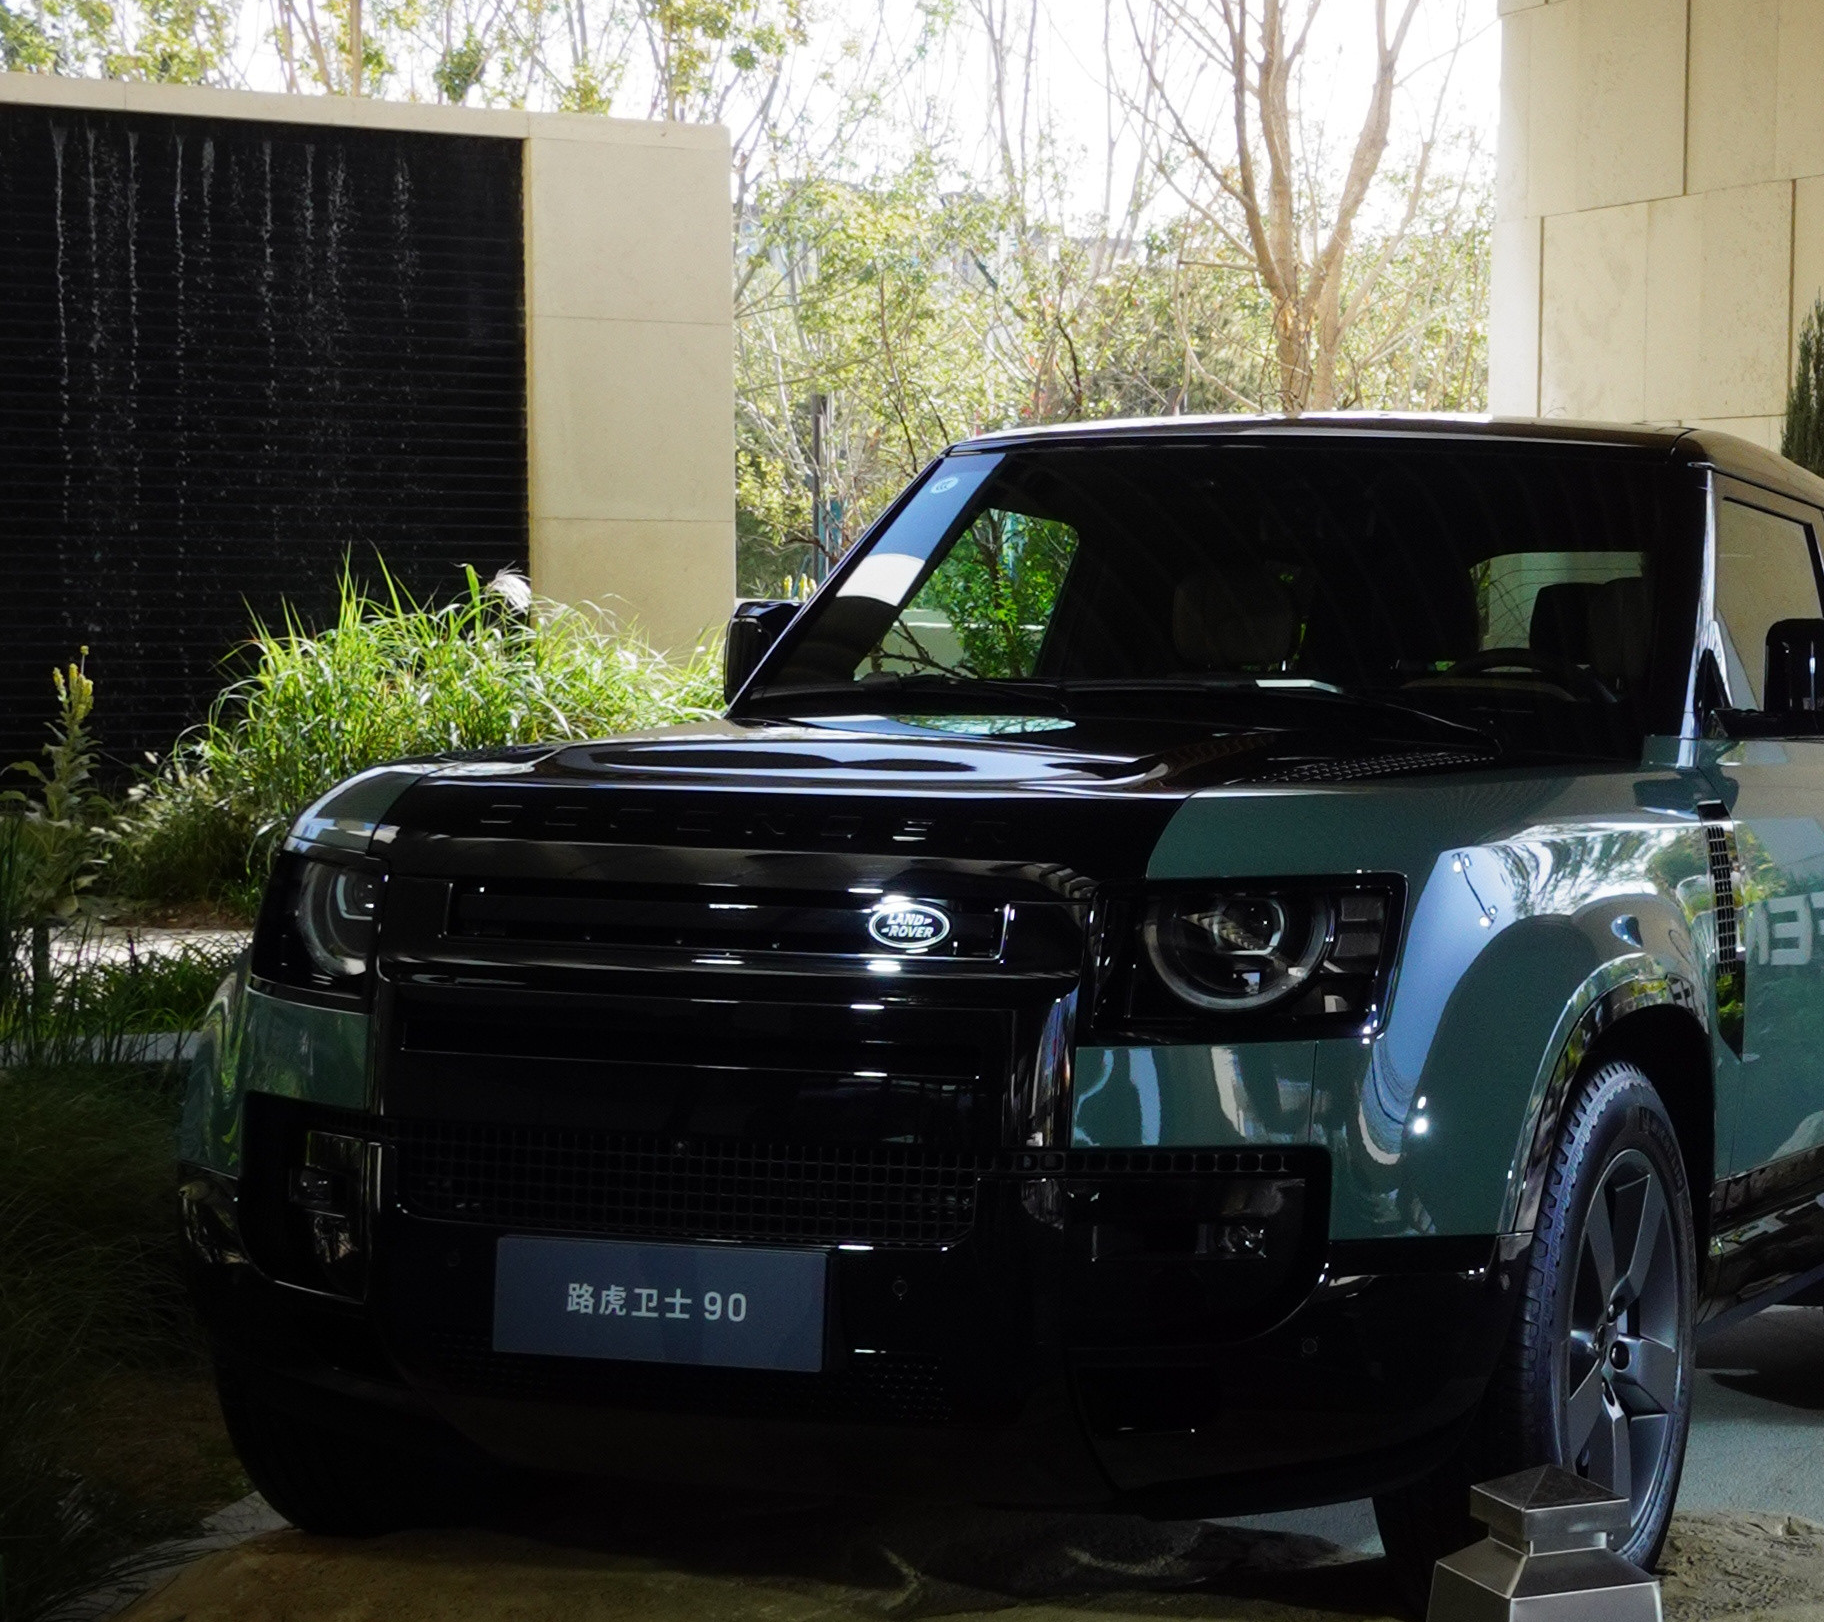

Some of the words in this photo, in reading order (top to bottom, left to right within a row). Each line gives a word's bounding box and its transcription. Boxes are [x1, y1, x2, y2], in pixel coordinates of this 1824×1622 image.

[886, 911, 925, 925] LAND
[887, 925, 935, 938] ROVER
[566, 1283, 693, 1320] 路虎卫士
[703, 1291, 748, 1322] 90
